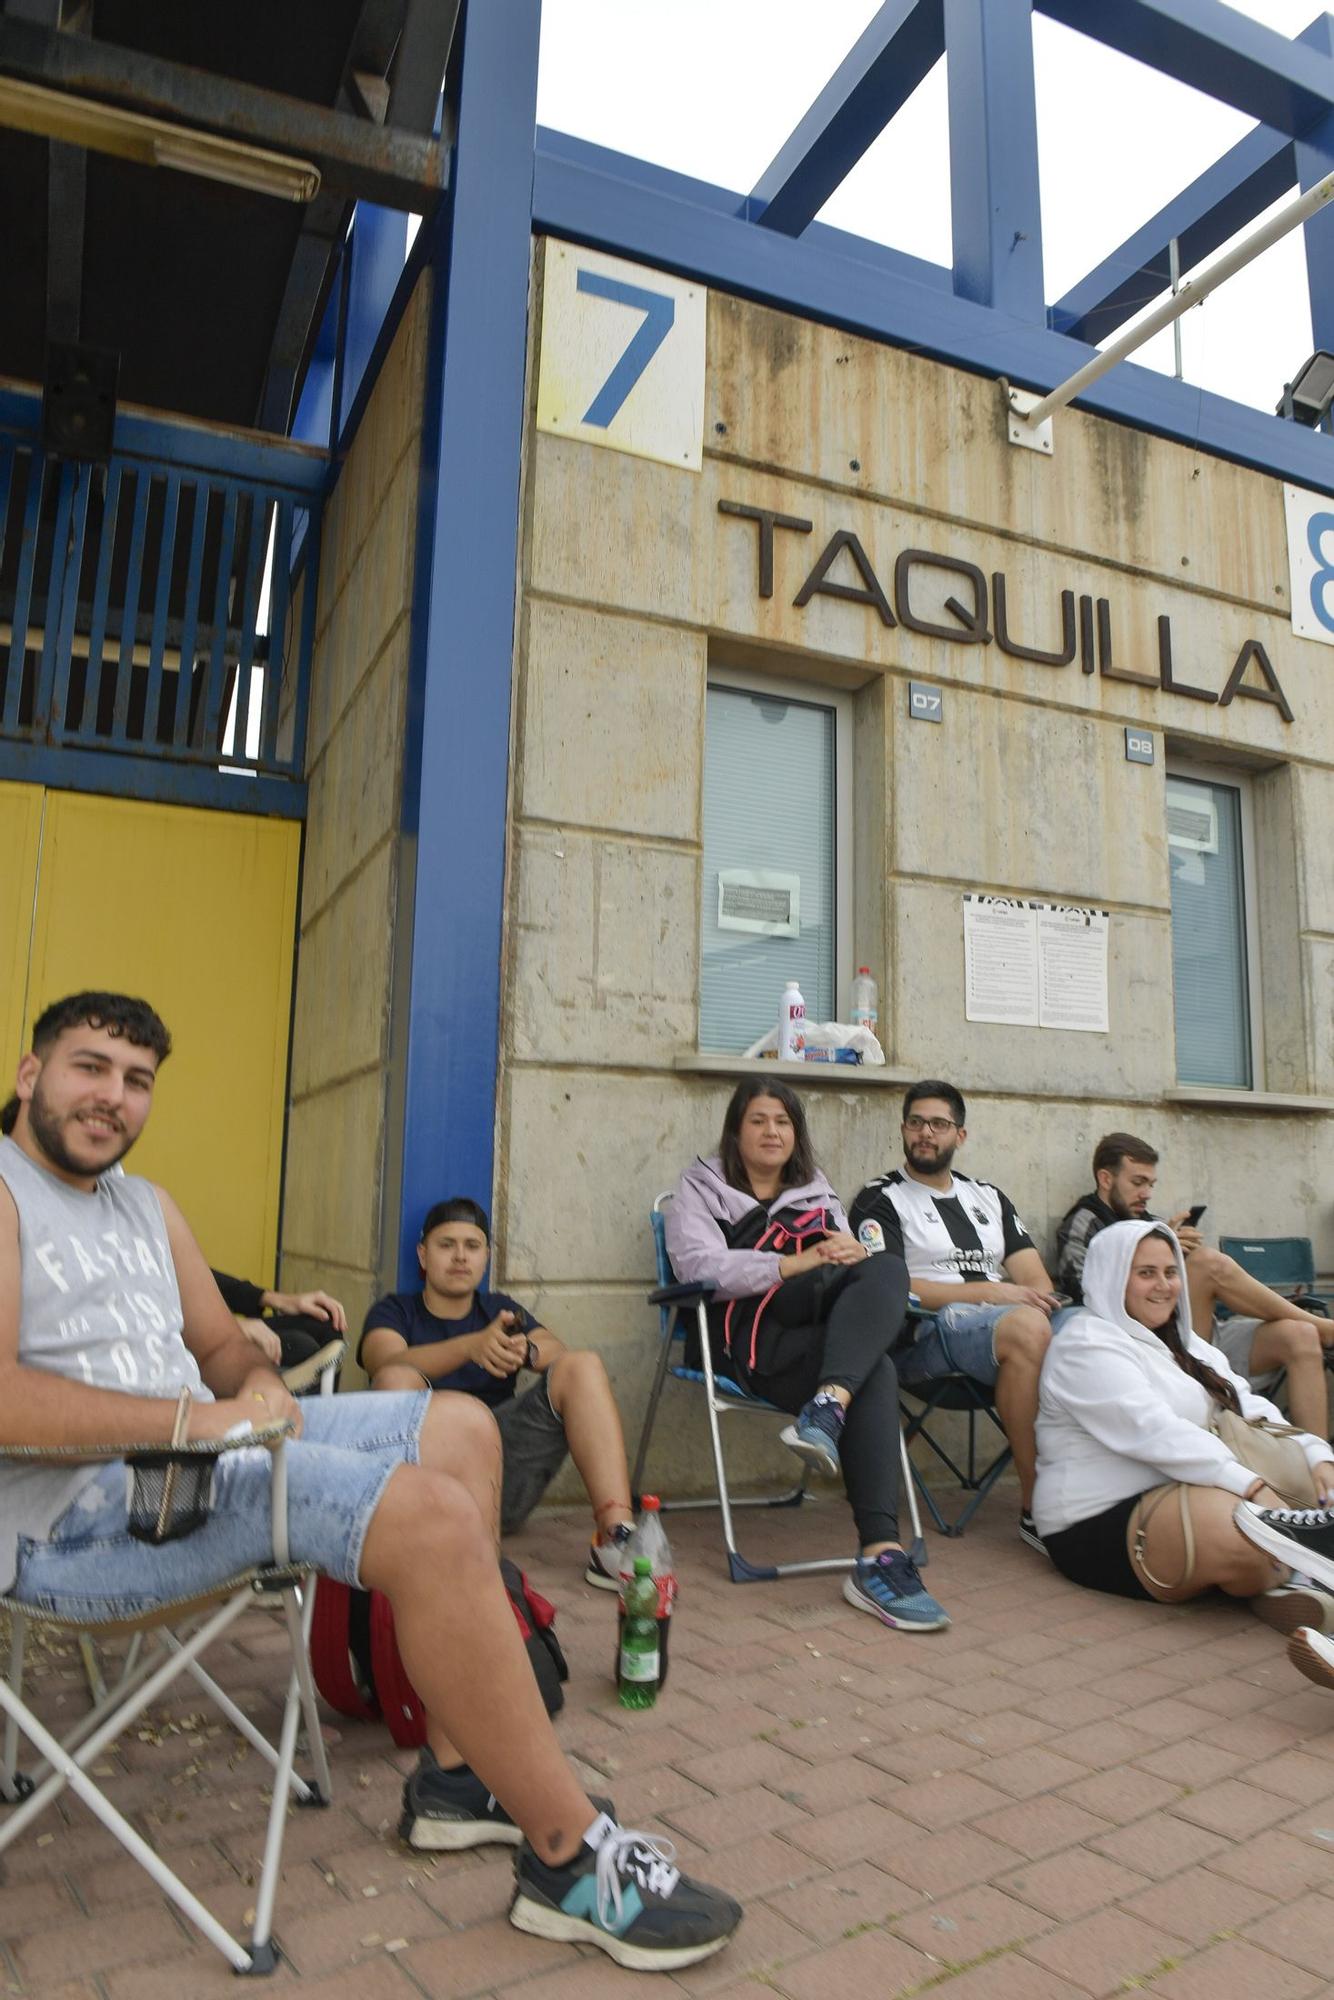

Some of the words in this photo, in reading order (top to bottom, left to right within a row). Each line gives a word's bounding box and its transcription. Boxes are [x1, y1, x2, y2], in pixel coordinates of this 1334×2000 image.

[576, 268, 675, 429] 7
[717, 499, 1295, 723] TAQUILLA
[912, 693, 941, 711] 07
[1127, 737, 1153, 755] 08
